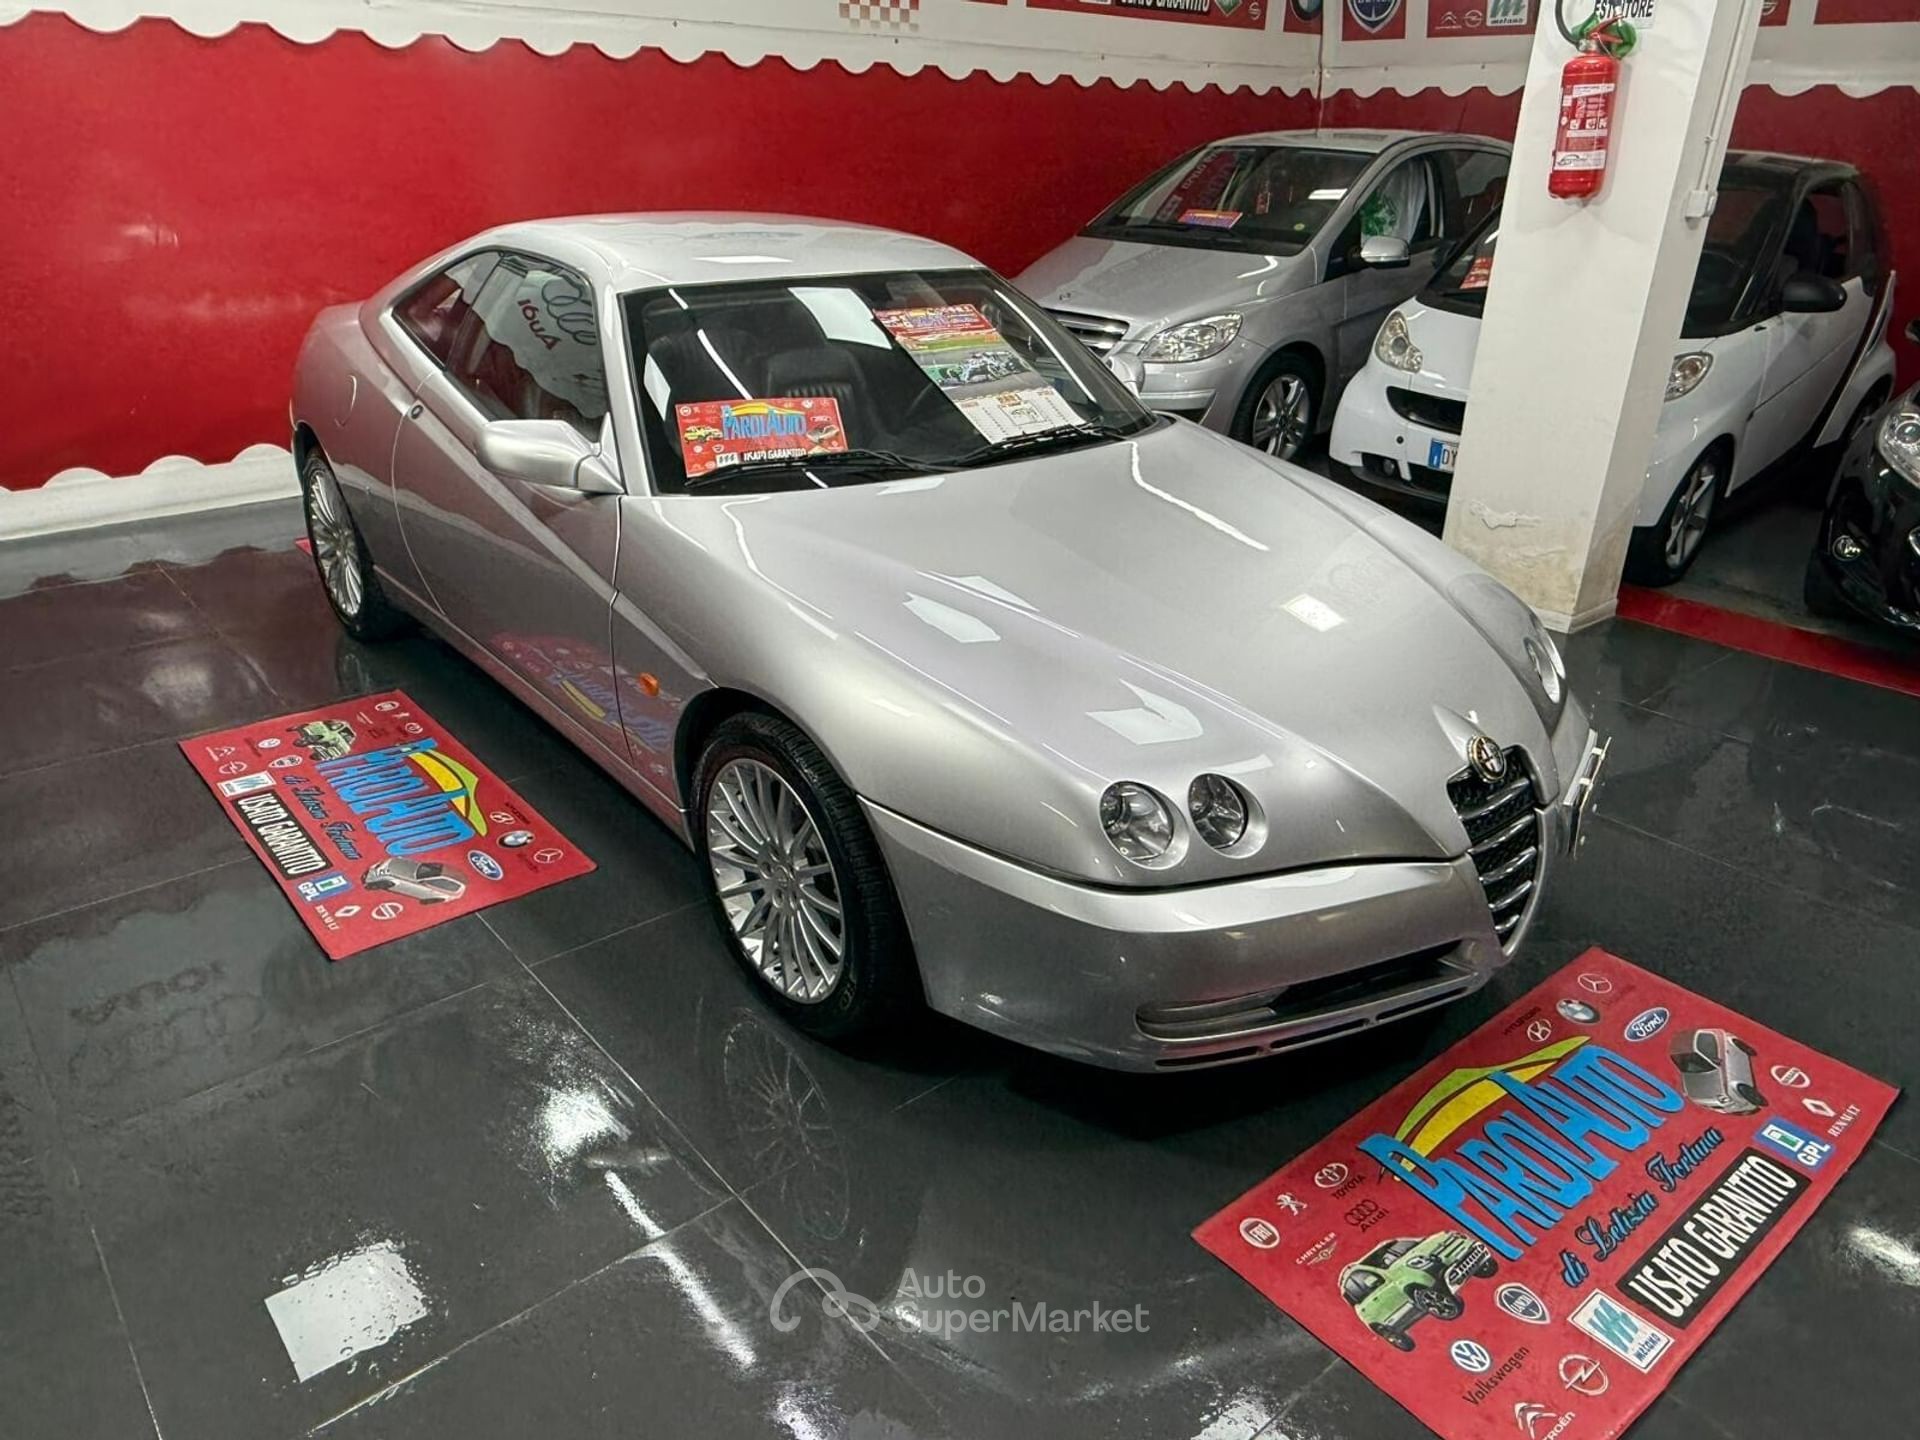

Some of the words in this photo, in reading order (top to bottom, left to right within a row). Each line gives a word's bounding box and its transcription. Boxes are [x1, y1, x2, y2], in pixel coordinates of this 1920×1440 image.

[237, 793, 288, 825] USATO
[257, 820, 326, 875] GARANTITO
[298, 881, 321, 902] GPL
[1631, 1012, 1664, 1038] Ford
[1827, 1104, 1861, 1138] RENAULT
[1797, 1140, 1832, 1167] GPL
[1331, 1174, 1367, 1200] TOYOTA
[1359, 1208, 1390, 1233] Audi
[1559, 1249, 1590, 1287] di
[1575, 1190, 1660, 1261] Letizia
[1645, 1126, 1726, 1193] Fortuna
[1295, 1231, 1337, 1265] CHRYSLER
[1628, 1237, 1721, 1318] USATO
[1683, 1155, 1798, 1260] GARANTITO
[1462, 1346, 1531, 1407] Volkswagen
